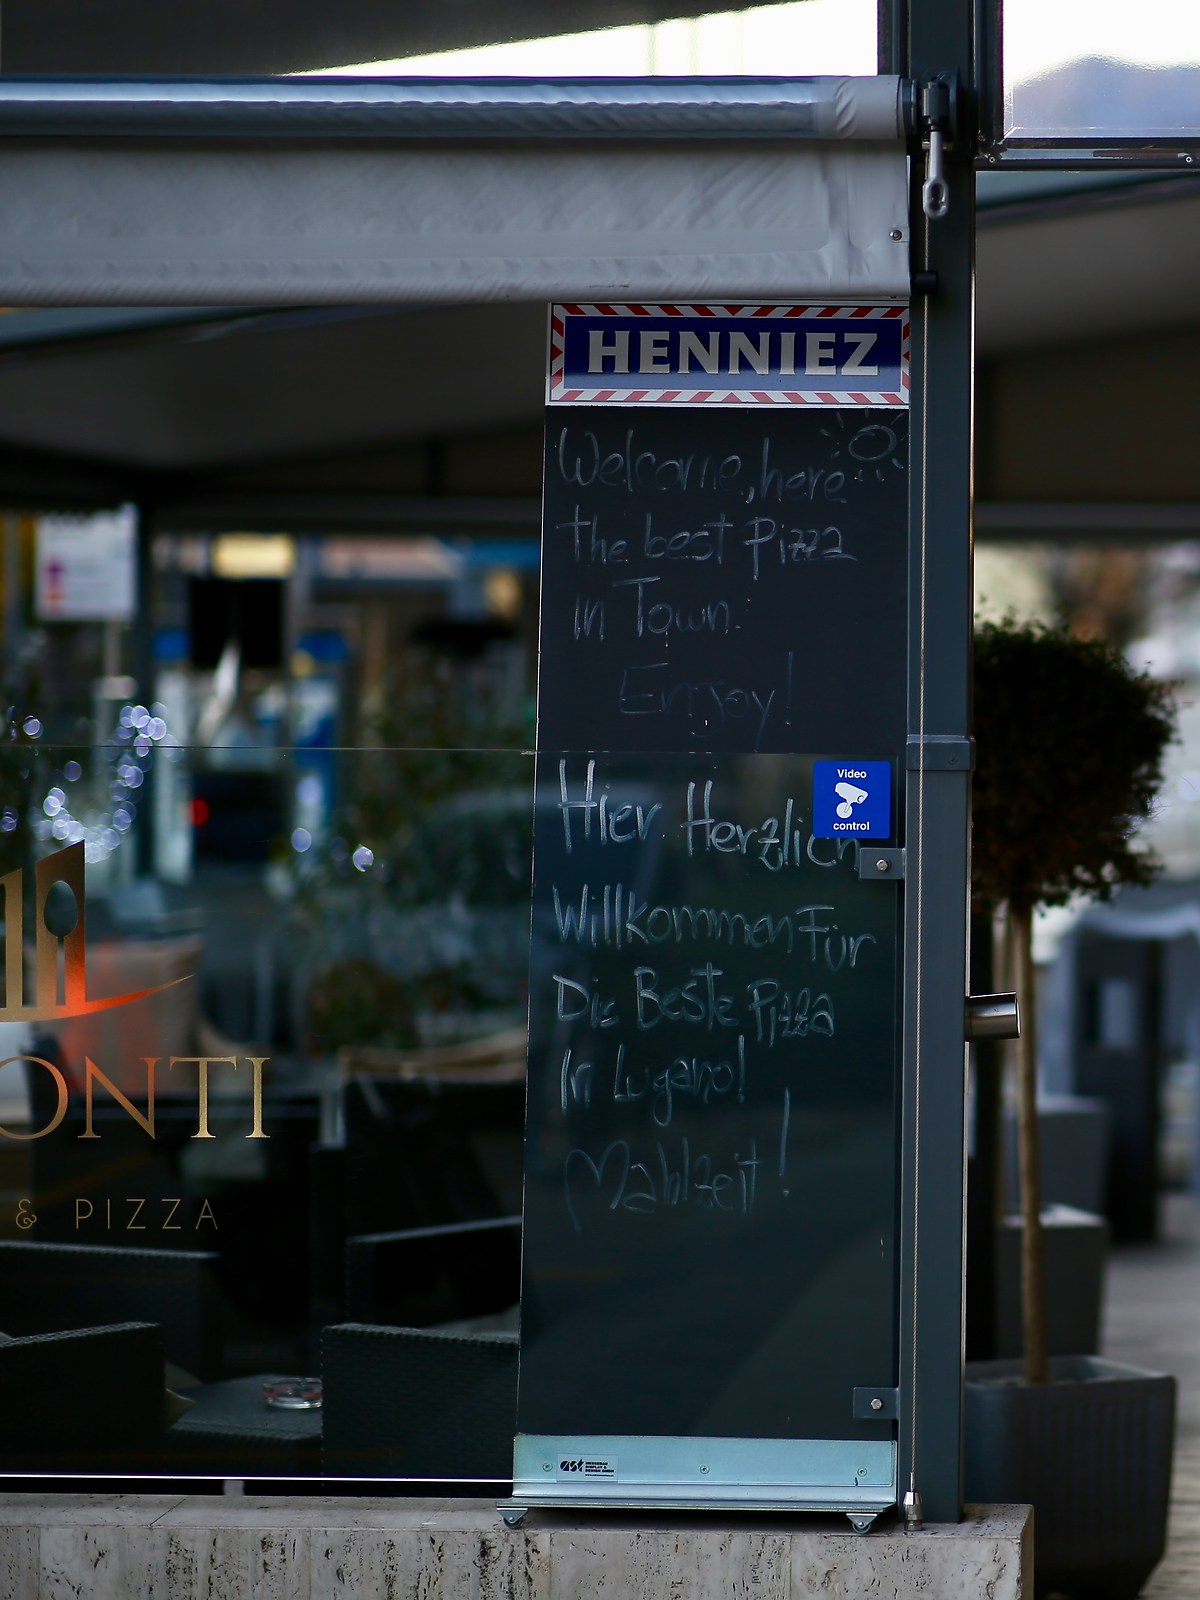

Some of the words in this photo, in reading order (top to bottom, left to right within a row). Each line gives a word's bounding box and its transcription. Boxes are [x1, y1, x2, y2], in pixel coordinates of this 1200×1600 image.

[588, 330, 879, 376] HENNIEZ
[761, 437, 848, 504] here
[556, 505, 628, 564] the
[645, 513, 733, 565] best
[837, 768, 867, 779] Video
[558, 758, 663, 854] Hier
[833, 821, 870, 831] control
[553, 883, 793, 954] Willkommen
[634, 962, 740, 1030] Beste
[746, 978, 836, 1048] Pizza
[15, 1199, 37, 1229] &
[76, 1199, 218, 1229] PIZZA
